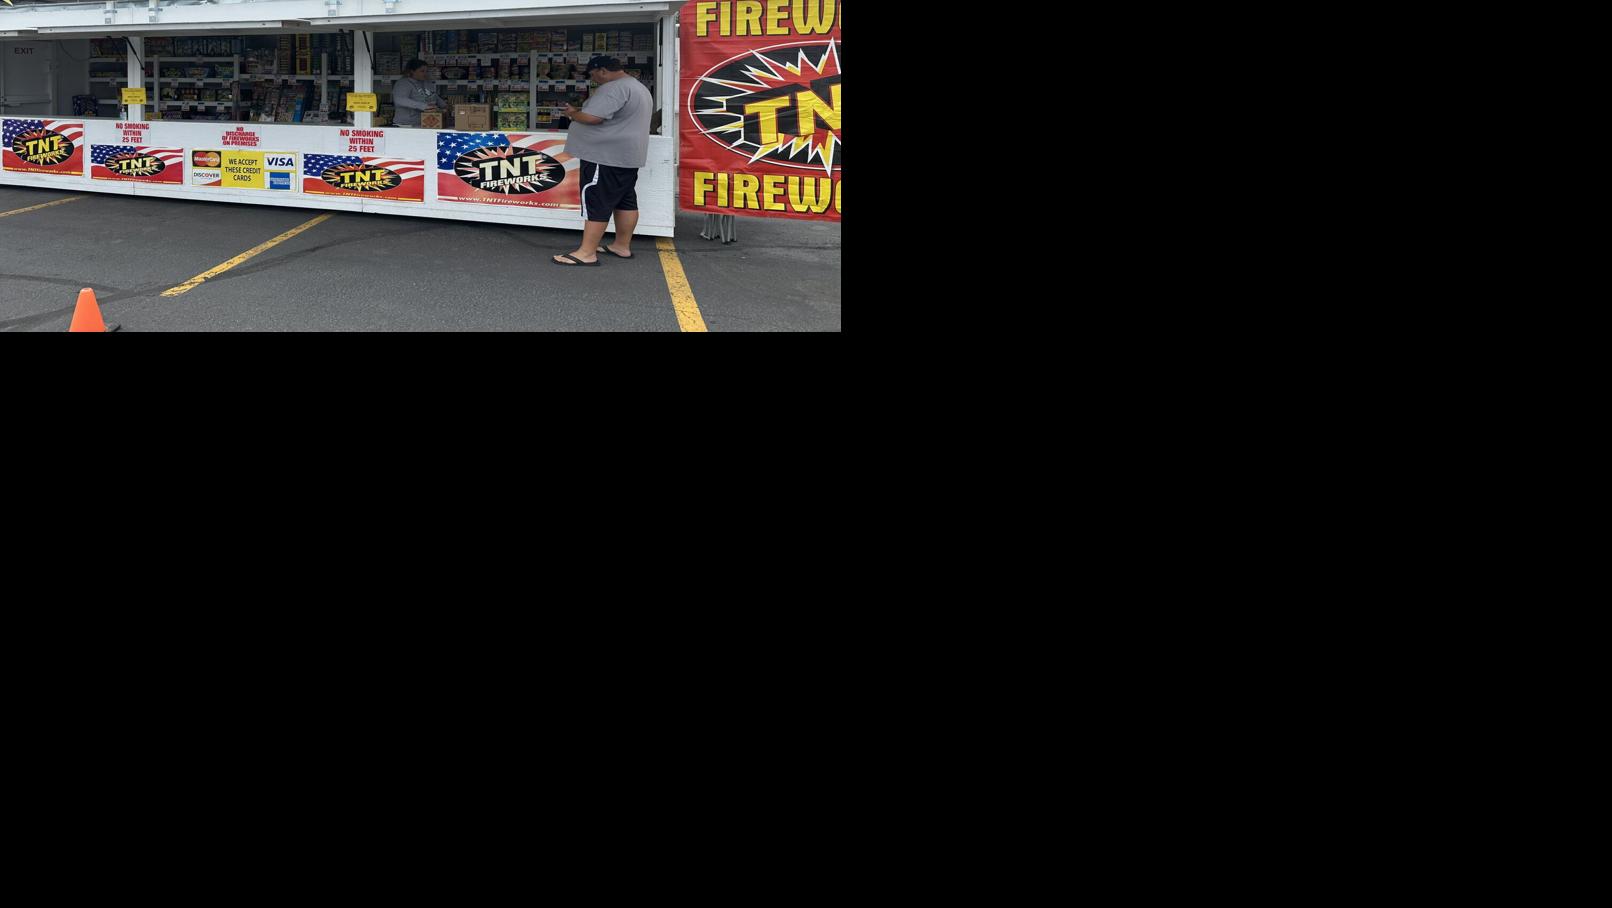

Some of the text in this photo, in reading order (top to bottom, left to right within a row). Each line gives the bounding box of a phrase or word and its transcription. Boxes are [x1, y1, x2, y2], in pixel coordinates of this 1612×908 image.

[696, 0, 841, 37] FIREW
[14, 47, 35, 55] EXIT
[115, 122, 124, 130] NO
[339, 129, 384, 138] NO SMOKING
[26, 134, 62, 156] TNT
[119, 156, 155, 170] TNT
[267, 157, 294, 167] VISA
[479, 154, 542, 181] TNT
[232, 174, 252, 182] CARDS
[242, 167, 261, 175] CREDIT
[340, 169, 385, 184] TNT
[480, 173, 549, 189] FIREWORKS
[693, 171, 841, 214] FIREW
